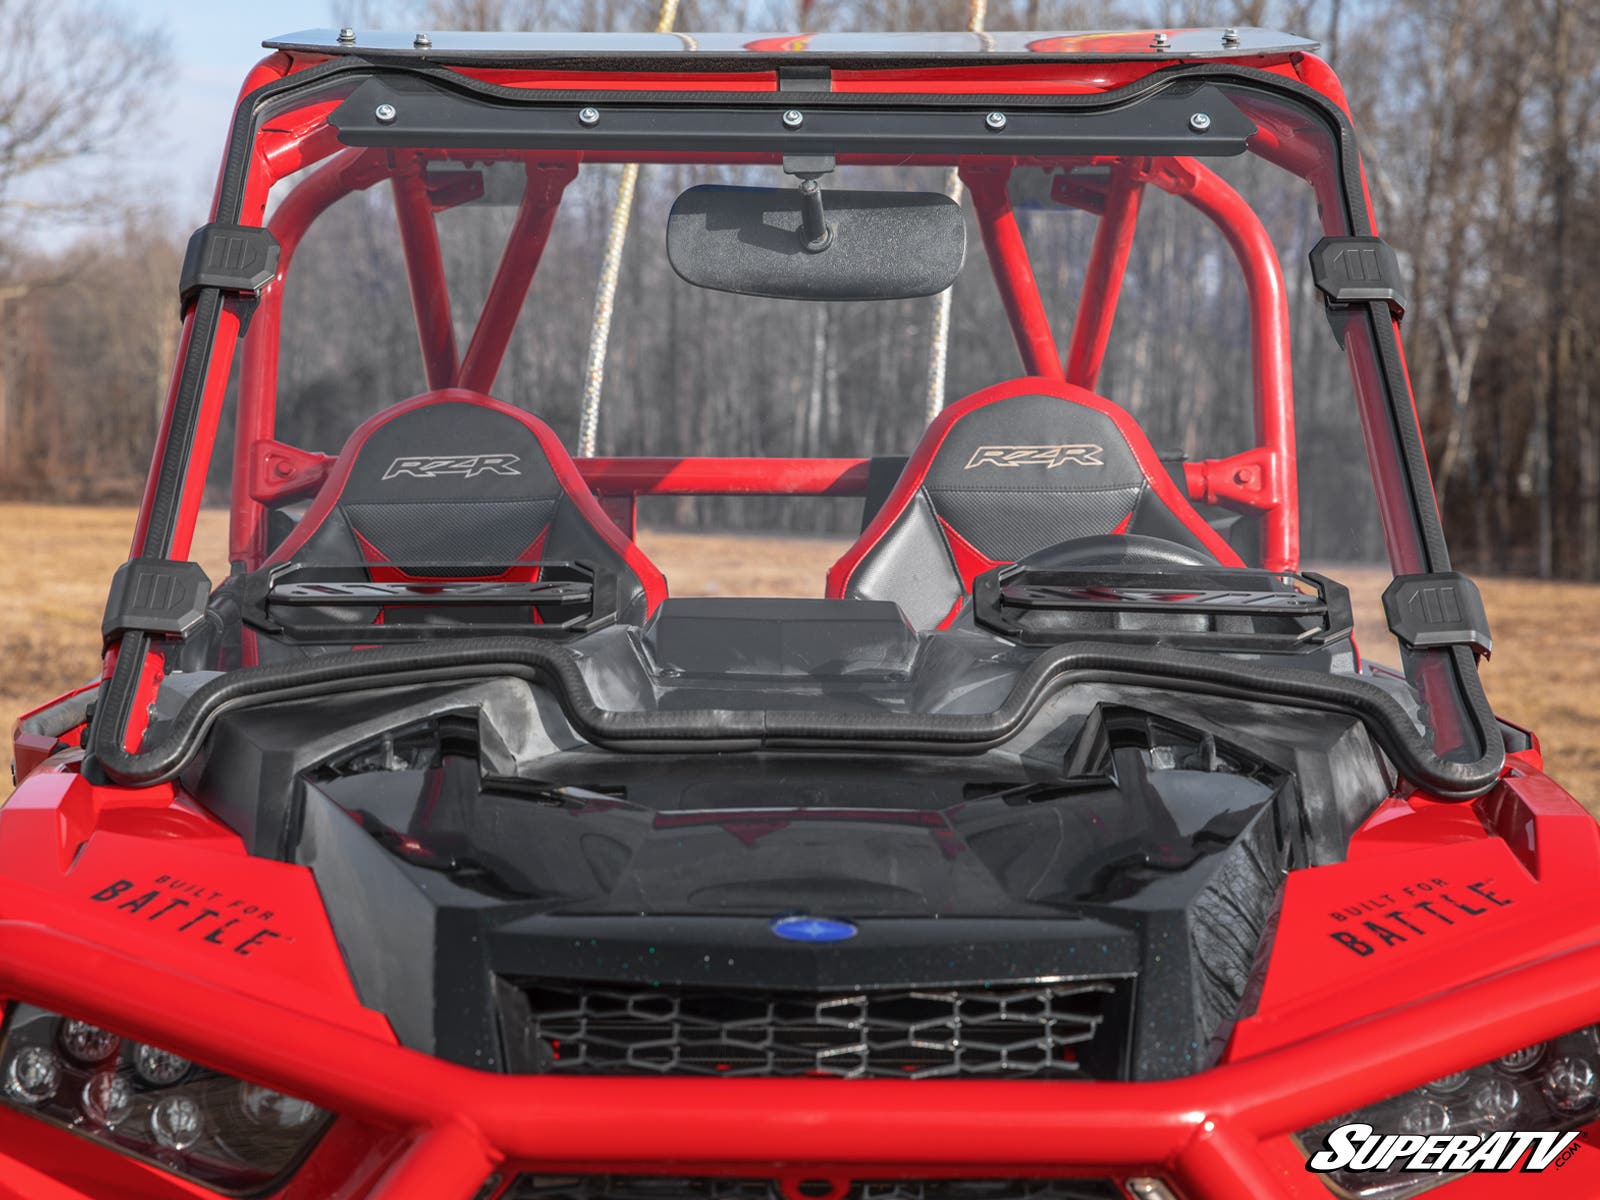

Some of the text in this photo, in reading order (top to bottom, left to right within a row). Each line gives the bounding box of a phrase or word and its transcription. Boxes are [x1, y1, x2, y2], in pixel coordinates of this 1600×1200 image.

[381, 454, 522, 480] RZR
[964, 444, 1104, 470] RZR
[90, 879, 279, 955] BATTLE
[155, 874, 274, 921] BUILT FOR
[1329, 877, 1449, 922] BUILT FOR
[1329, 881, 1513, 957] BATTLE
